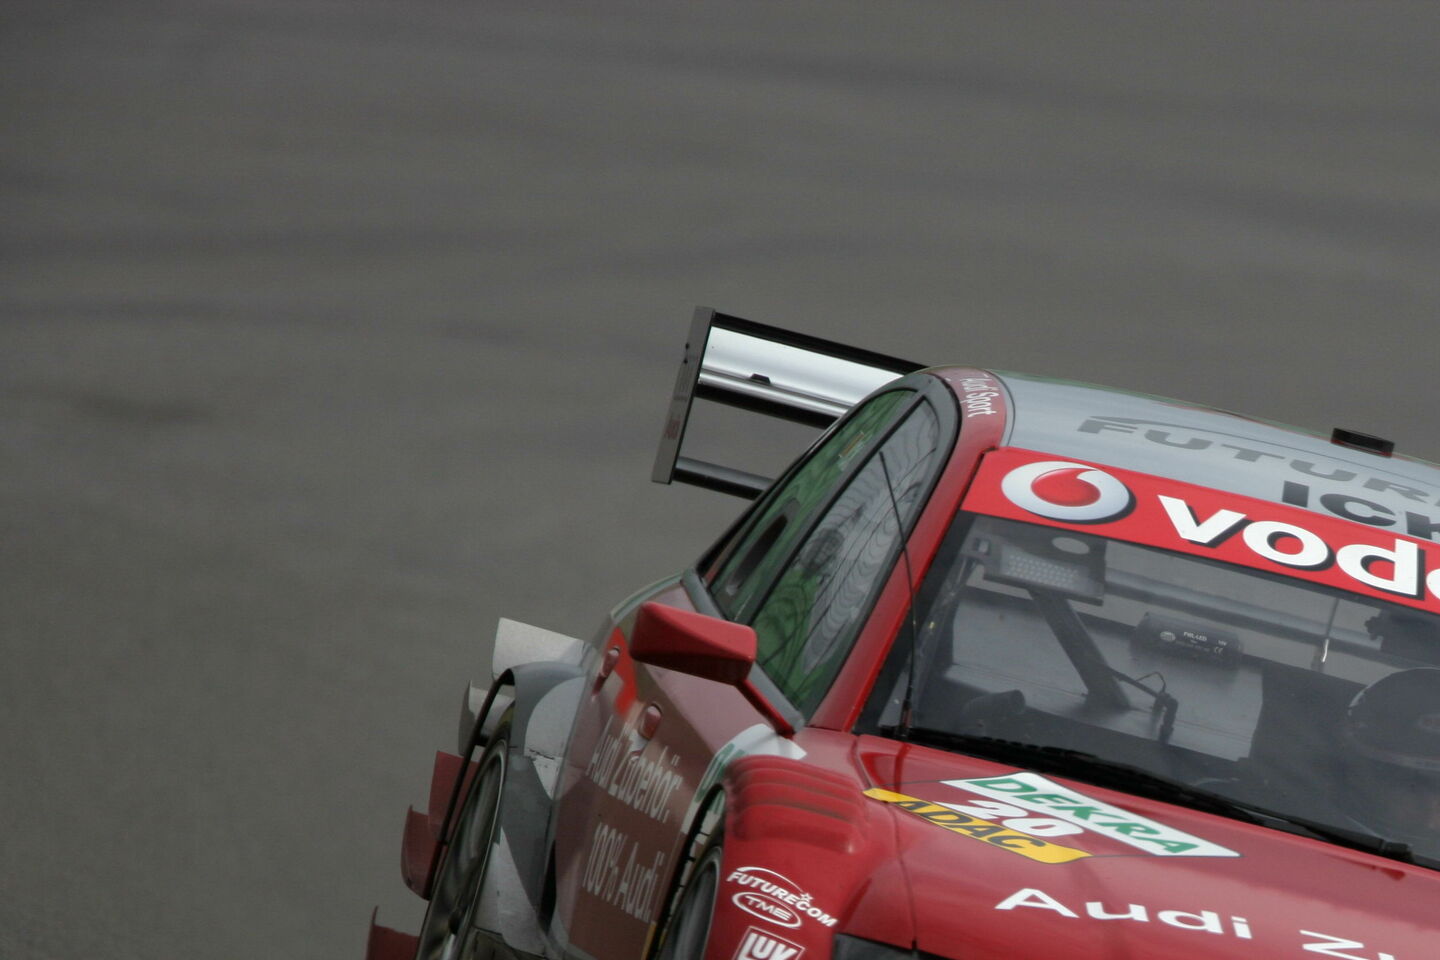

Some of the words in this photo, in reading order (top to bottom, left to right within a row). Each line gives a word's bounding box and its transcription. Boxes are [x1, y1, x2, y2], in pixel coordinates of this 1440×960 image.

[960, 391, 999, 418] Sport
[898, 800, 1049, 851] ADAC
[932, 799, 1084, 837] 20
[966, 778, 1200, 854] DEKRA
[727, 871, 838, 928] FUTURECOM
[745, 895, 792, 923] TME
[994, 887, 1252, 940] Audi
